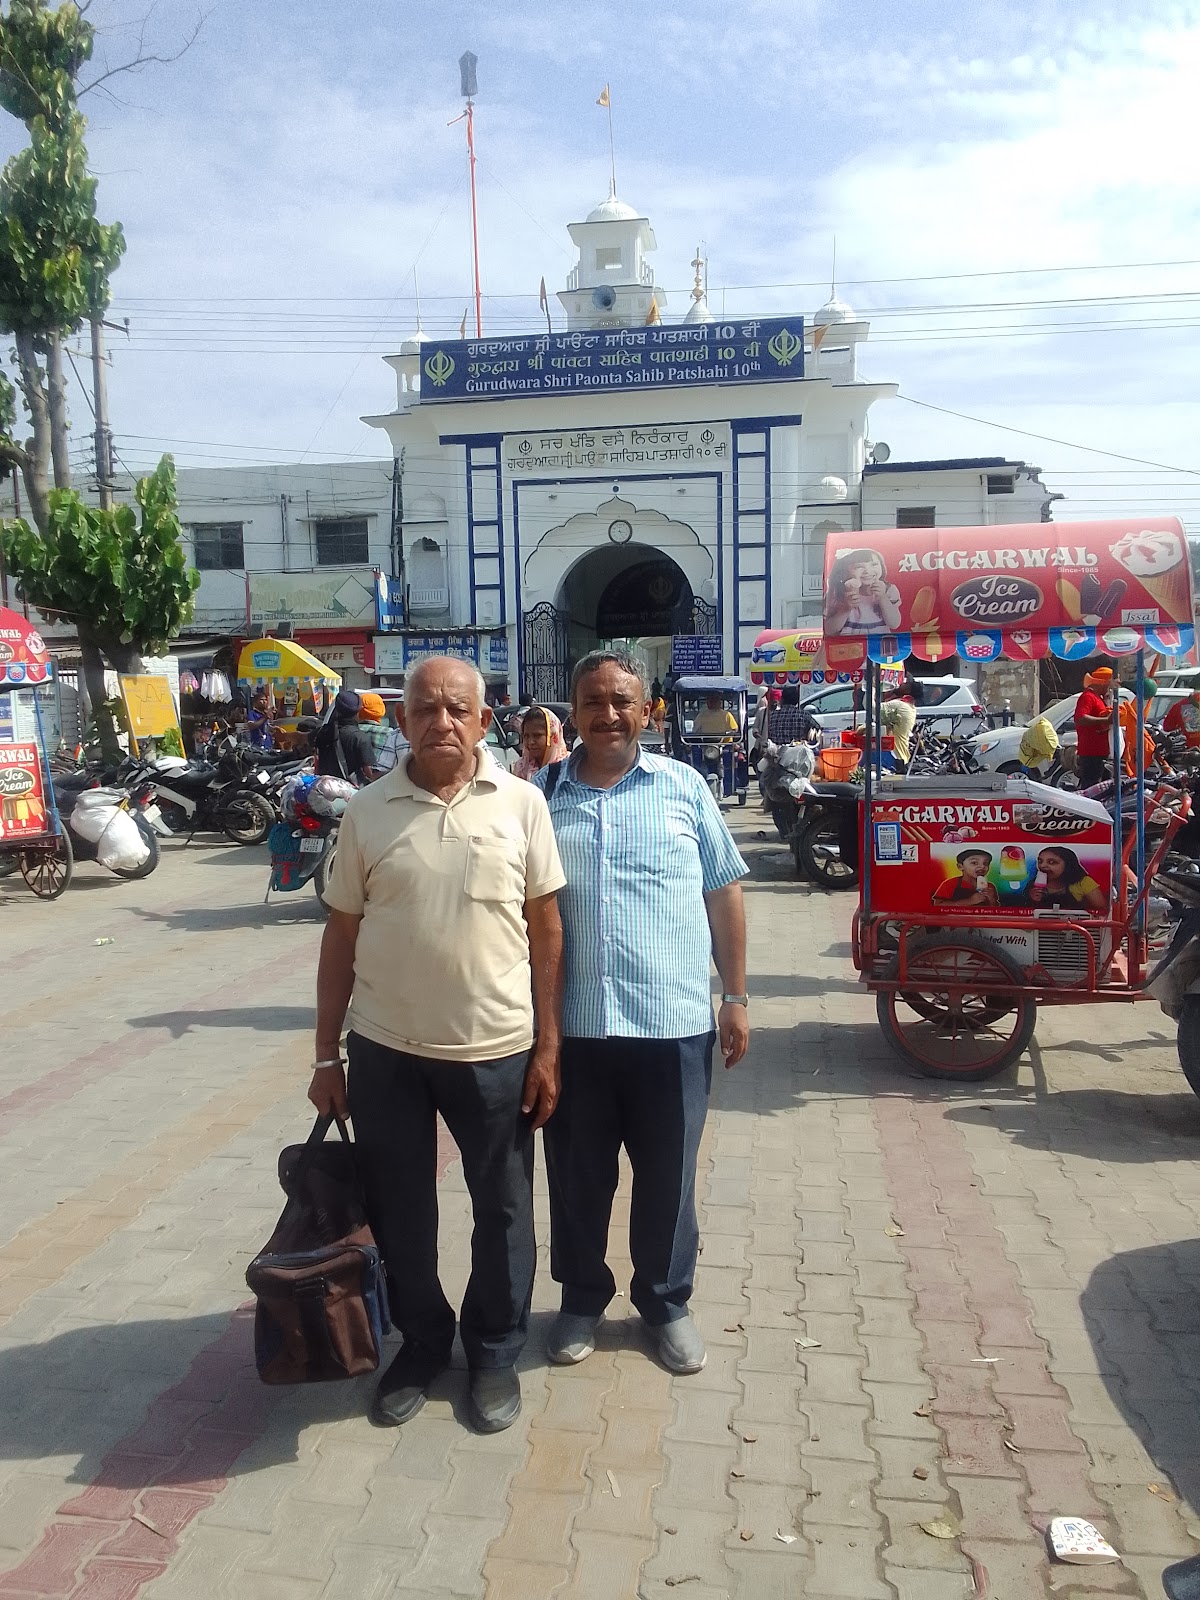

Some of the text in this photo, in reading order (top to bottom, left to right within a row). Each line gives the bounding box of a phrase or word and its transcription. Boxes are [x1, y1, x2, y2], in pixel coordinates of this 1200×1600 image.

[467, 340, 530, 358] ਗੁਰਦੁਆਰਾ
[556, 333, 600, 351] ਪਾਉਂਟਾ
[605, 330, 647, 346] ਸਾਹਿਬ
[652, 325, 708, 344] ਪਾਤਸ਼ਾਹੀ
[714, 326, 735, 340] 10
[742, 321, 761, 338] ਵੀਂ
[467, 341, 761, 378] गुरुद्वारा श्री पांवटा साहिब पातशाही 10 वीं
[465, 361, 761, 392] Gurudwara Shri Paonta Sahib Patshahi 10th
[540, 438, 563, 449] ਸਚ
[602, 430, 625, 446] ਵਸੈ
[610, 448, 644, 462] ਸਾਹਿਬ
[898, 547, 1098, 573] AGGARWAL
[979, 577, 1020, 598] Ice
[953, 594, 1039, 617] Cream
[0, 629, 22, 638] WAL
[310, 650, 345, 661] OFFEE
[5, 767, 24, 782] Ice
[1006, 934, 1027, 946] With
